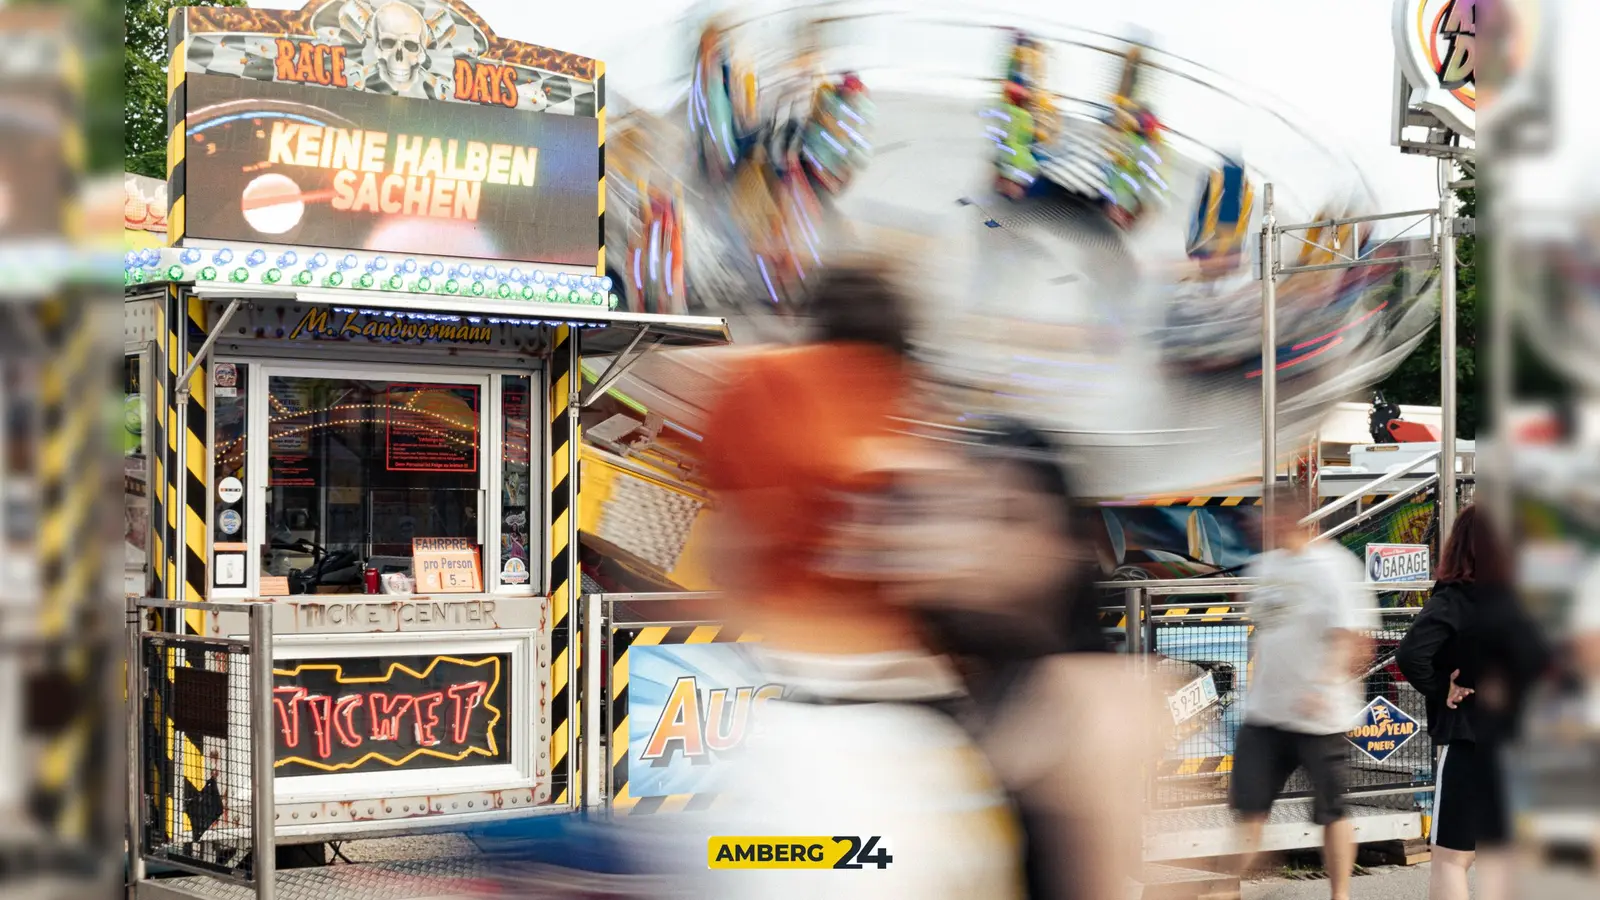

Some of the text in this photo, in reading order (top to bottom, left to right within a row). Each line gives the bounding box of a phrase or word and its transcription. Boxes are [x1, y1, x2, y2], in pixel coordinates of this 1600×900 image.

[274, 38, 518, 109] RACE DAYS
[268, 122, 538, 188] KEINE HALBEN
[331, 169, 482, 220] SACHEN
[289, 306, 493, 343] M. Landwermann
[424, 557, 473, 572] pro Person
[1383, 552, 1427, 578] GARAGE
[273, 681, 488, 758] TICKET
[1367, 740, 1396, 752] PNEUS
